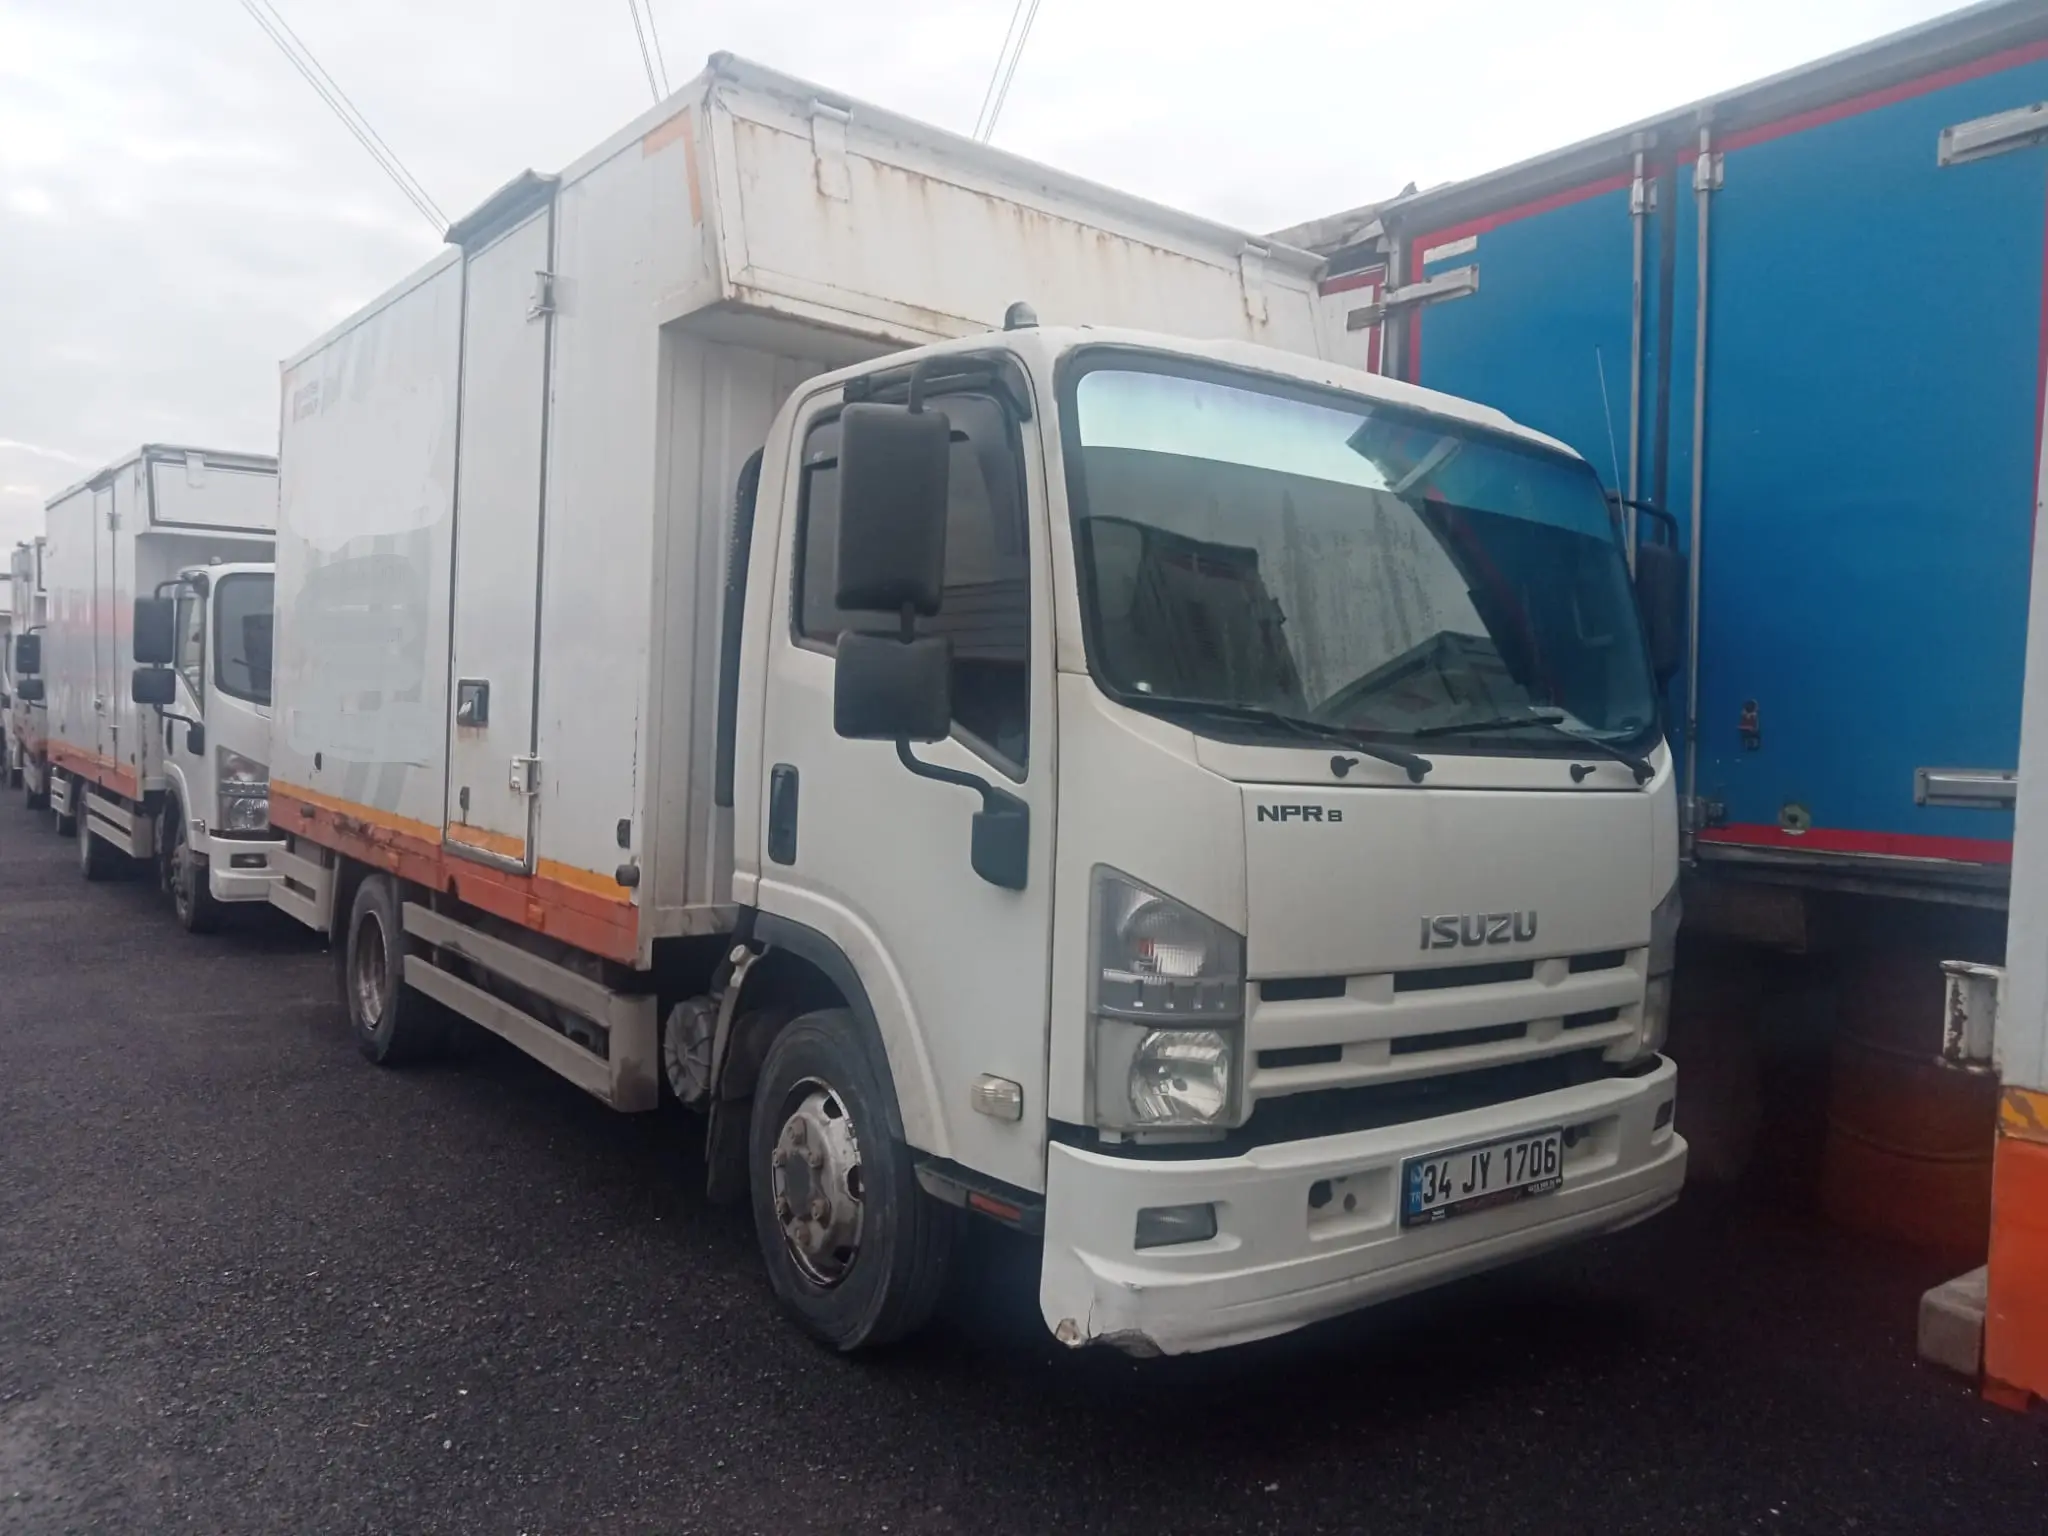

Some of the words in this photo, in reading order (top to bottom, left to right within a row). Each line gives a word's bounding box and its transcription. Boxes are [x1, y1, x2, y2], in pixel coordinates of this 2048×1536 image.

[1257, 805, 1323, 822] NPR
[1420, 909, 1538, 950] ISUZU
[1422, 1161, 1452, 1204] 34
[1461, 1151, 1491, 1194] JY
[1503, 1137, 1557, 1185] 1706
